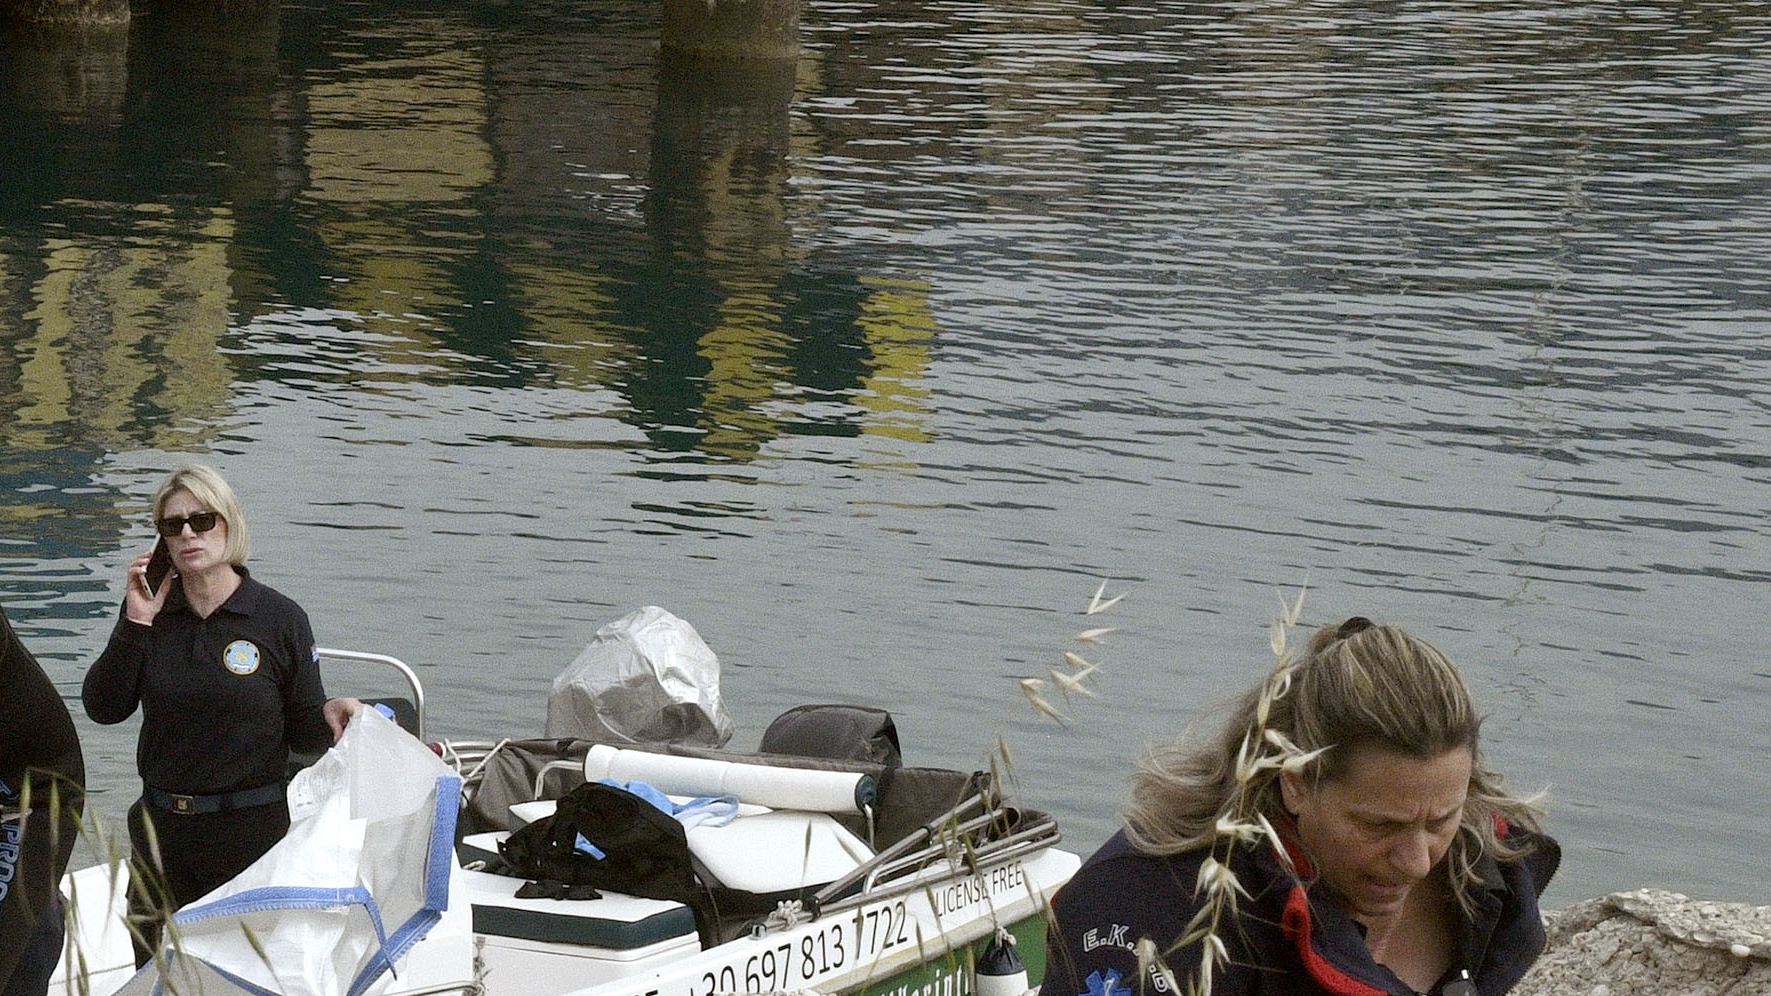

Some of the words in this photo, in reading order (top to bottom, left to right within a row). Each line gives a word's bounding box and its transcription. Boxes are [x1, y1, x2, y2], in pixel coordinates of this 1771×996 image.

[991, 860, 1022, 896] FREE
[746, 944, 792, 992] 697
[801, 924, 845, 980] 813
[852, 901, 908, 960] 7722
